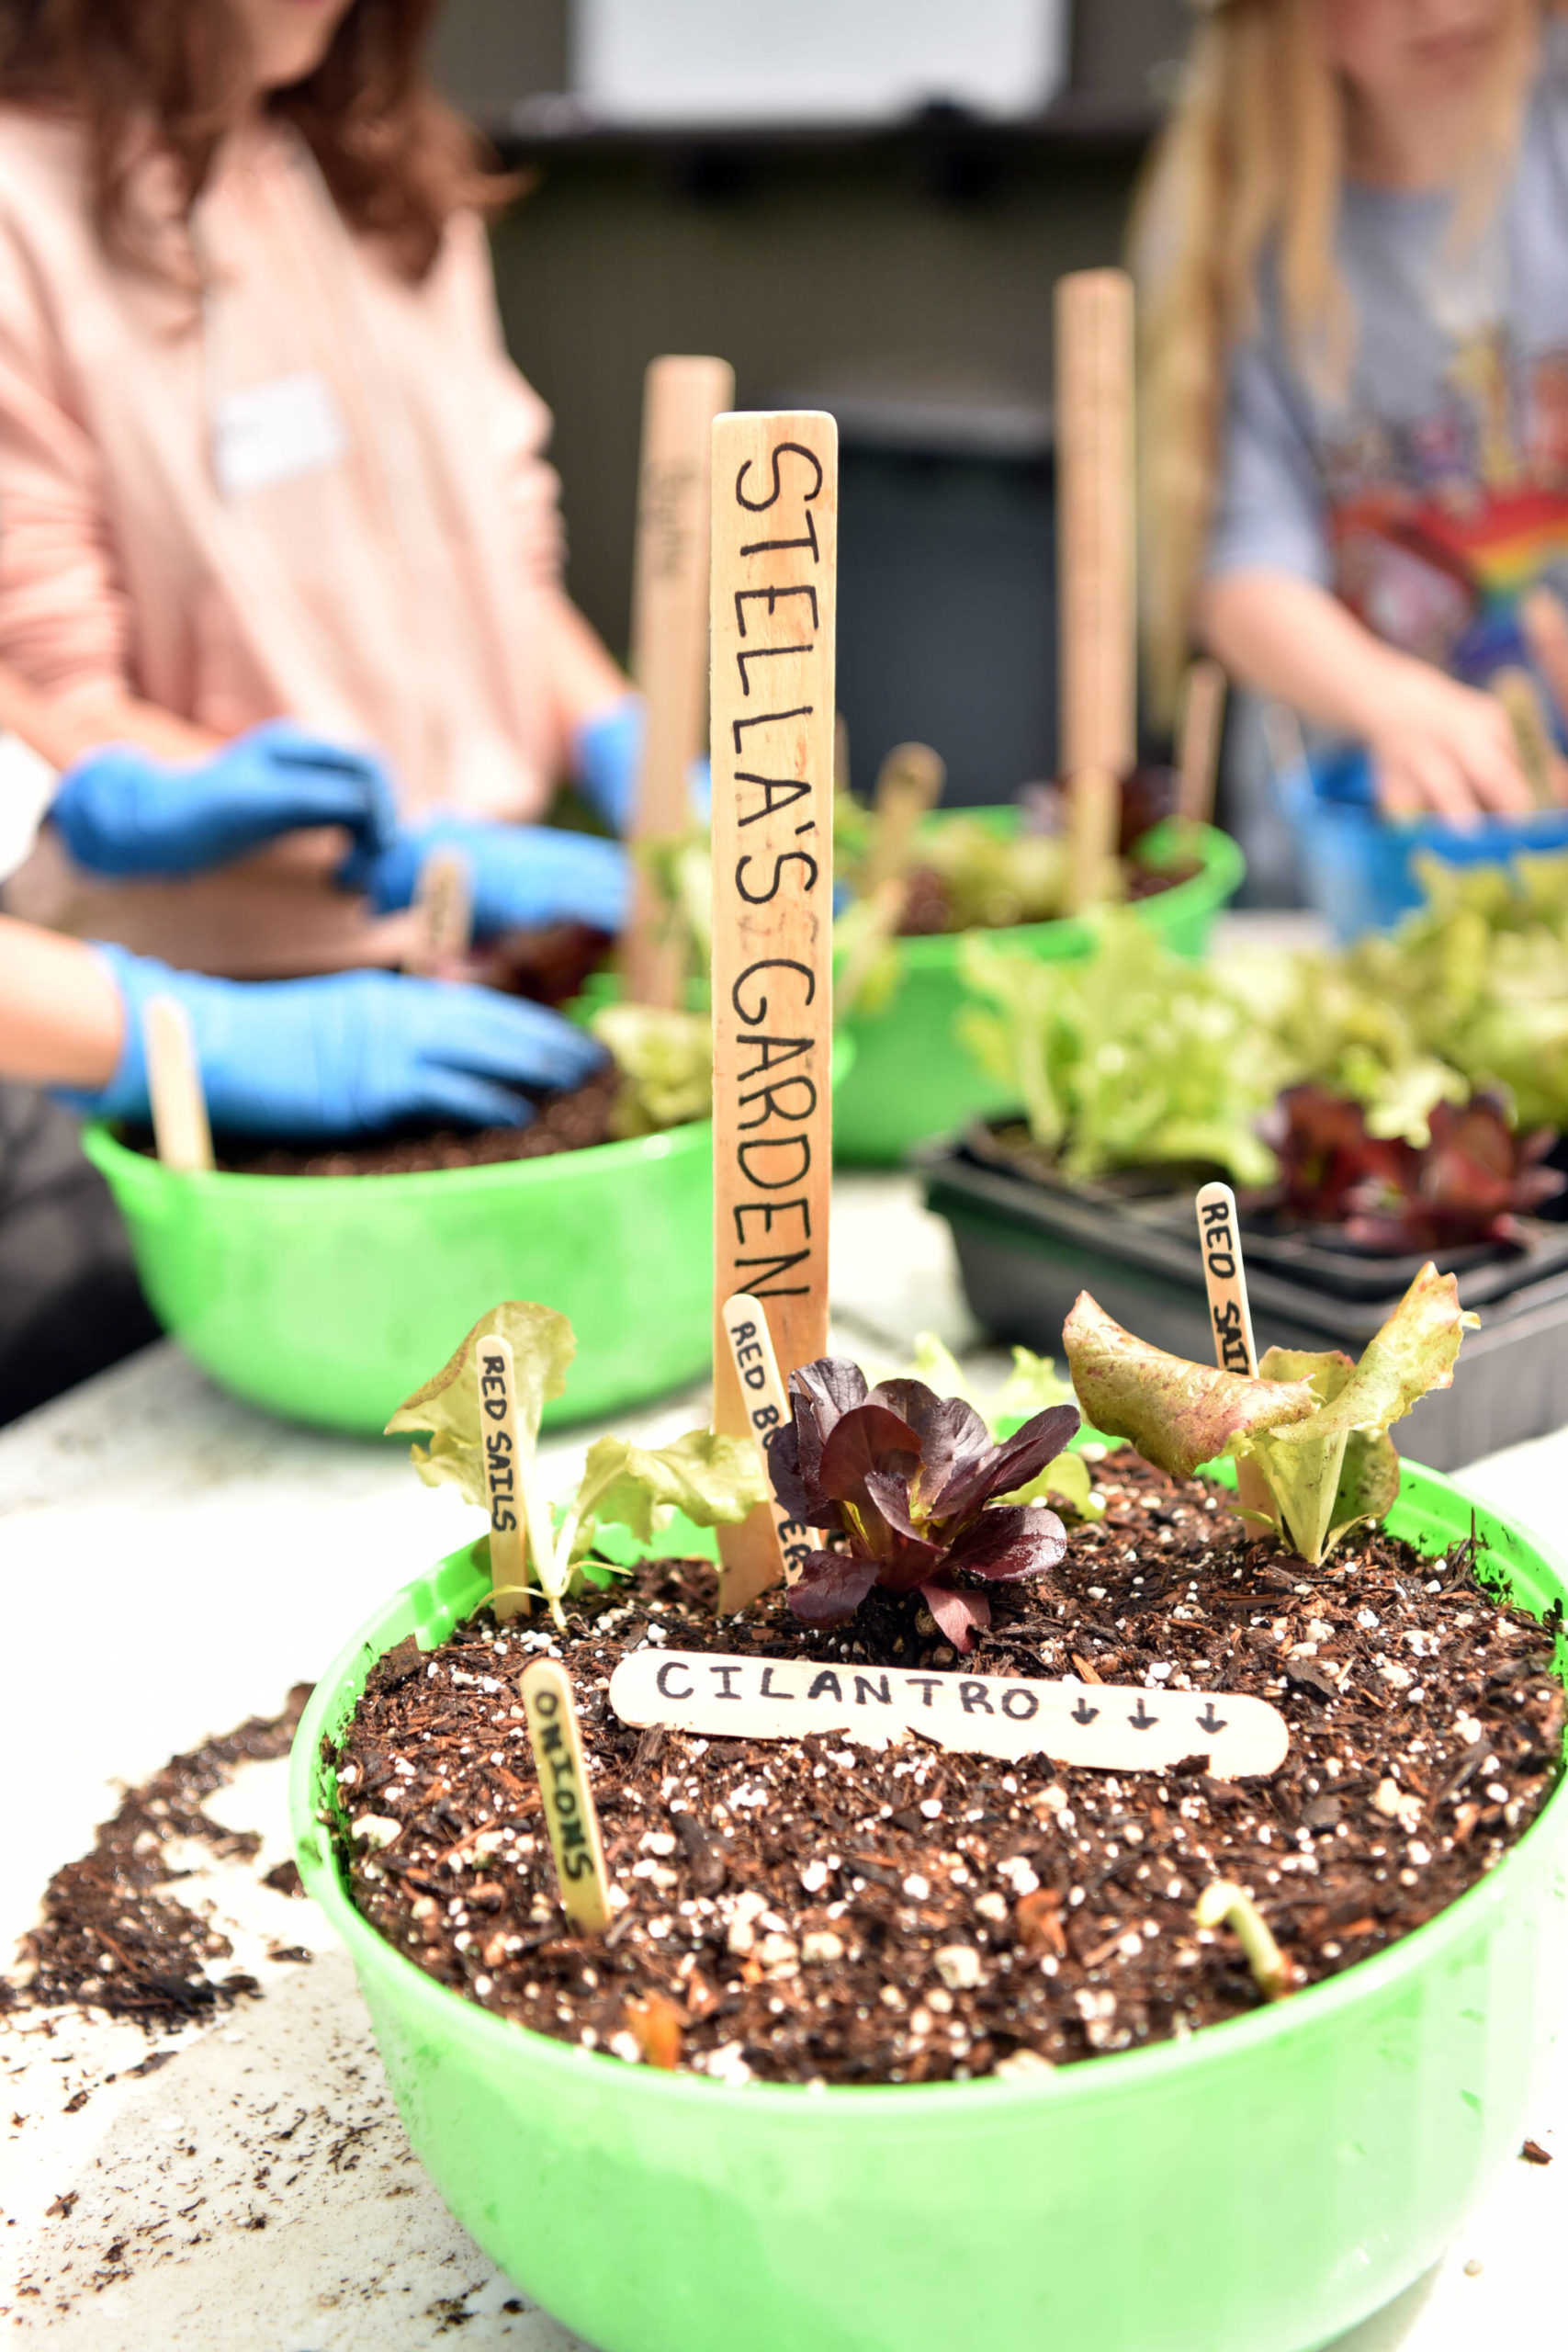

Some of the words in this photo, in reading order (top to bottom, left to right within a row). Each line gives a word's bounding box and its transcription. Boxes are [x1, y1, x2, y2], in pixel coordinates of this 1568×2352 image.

[732, 442, 823, 904] STELLA'S
[731, 958, 817, 1298] GARDEN
[1201, 1200, 1235, 1279] RED
[481, 1354, 508, 1421] RED
[729, 1320, 765, 1390] RED
[485, 1430, 517, 1532] SAILS
[656, 1660, 1040, 1721] CILANTRO
[533, 1690, 595, 1882] ONIONS
